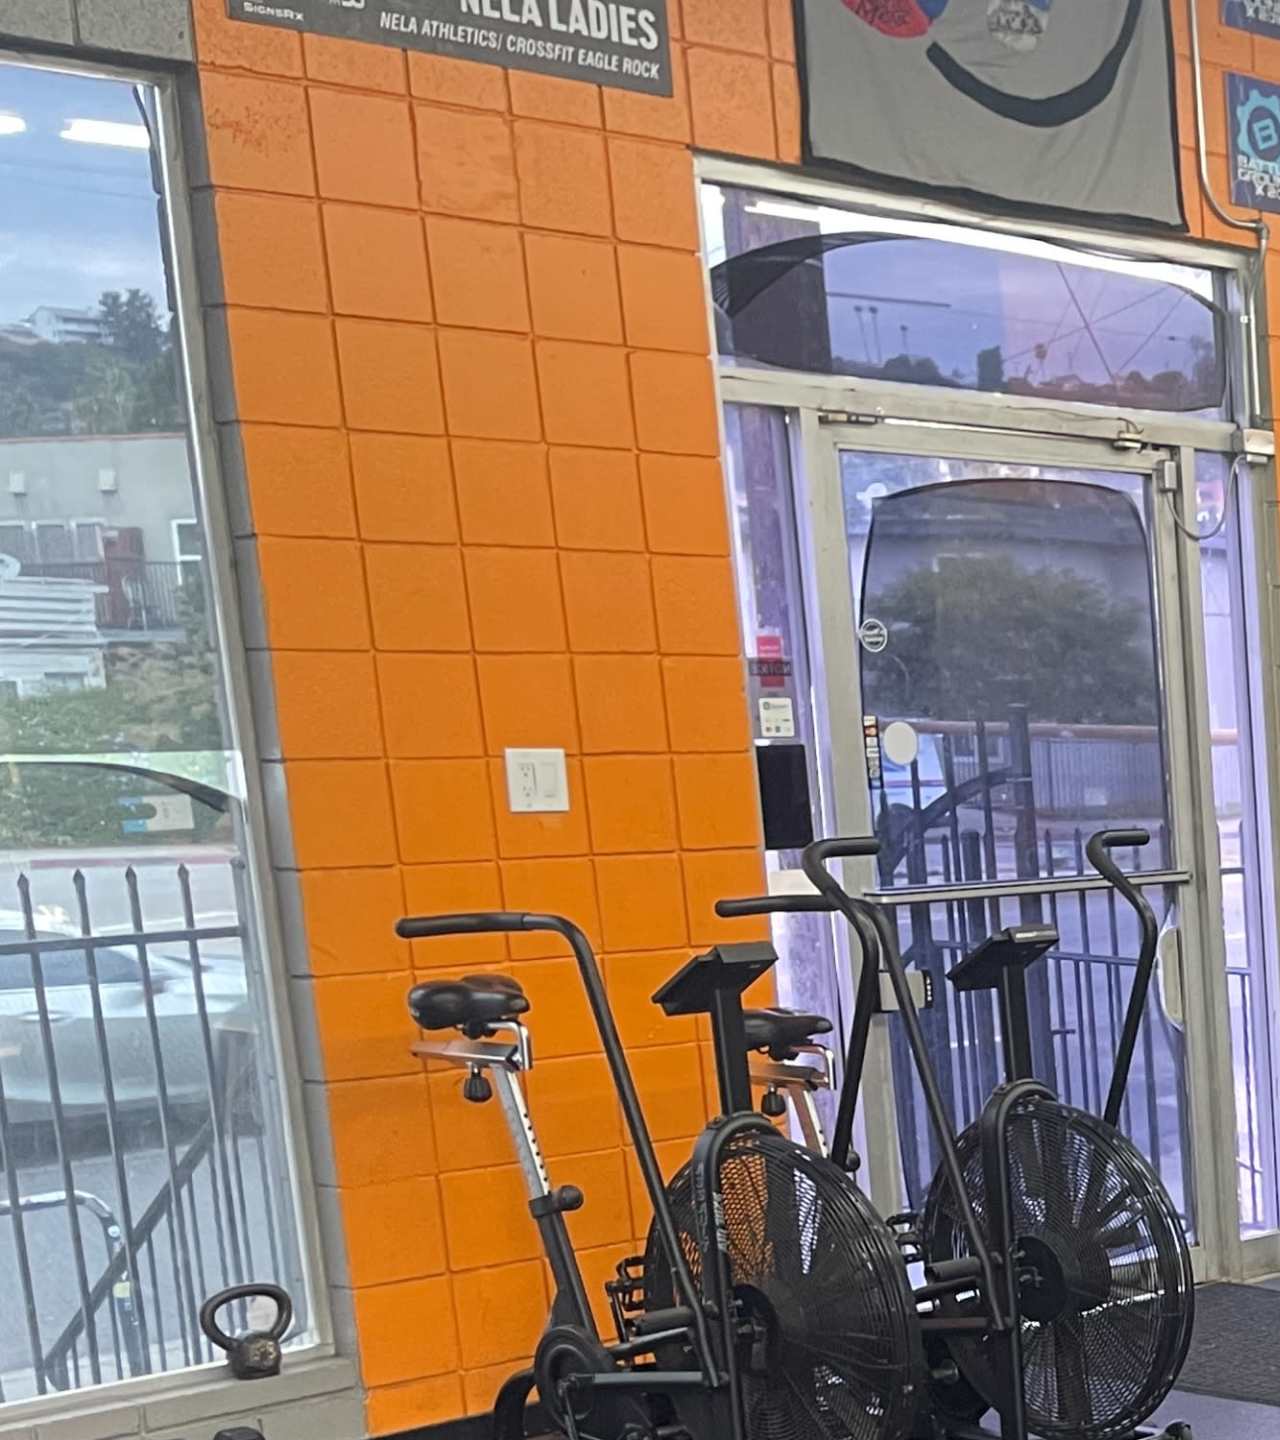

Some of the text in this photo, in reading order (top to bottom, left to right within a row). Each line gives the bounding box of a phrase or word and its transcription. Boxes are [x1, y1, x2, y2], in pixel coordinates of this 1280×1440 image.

[379, 11, 417, 34] NELA
[506, 34, 574, 63] CROSSFIT
[577, 49, 619, 72] EAGLE
[622, 57, 661, 80] ROCK
[548, 0, 659, 50] LADIES
